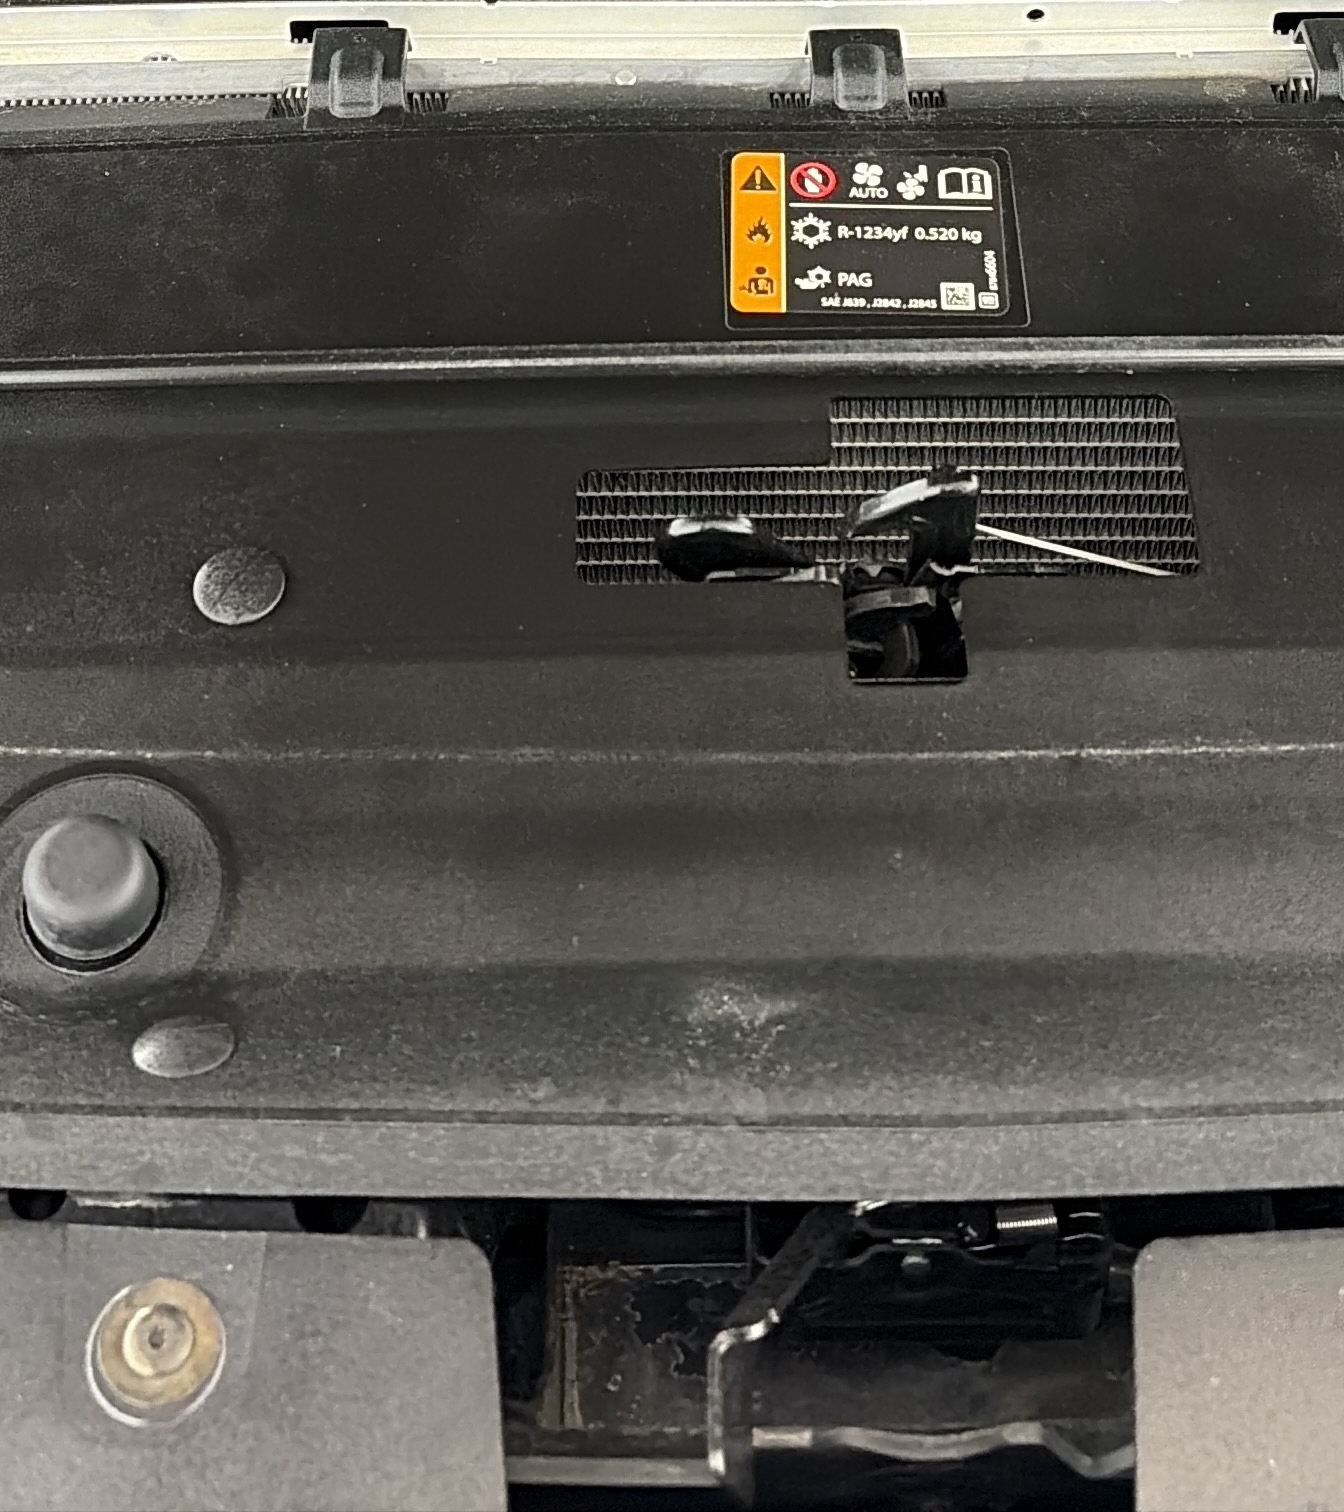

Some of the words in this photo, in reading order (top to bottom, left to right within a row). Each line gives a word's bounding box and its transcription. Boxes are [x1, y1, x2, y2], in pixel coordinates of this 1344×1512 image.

[849, 186, 889, 199] AUTO
[837, 225, 909, 242] R-1234yf
[914, 227, 959, 241] 0.520
[962, 227, 983, 244] kg
[837, 272, 873, 288] PAG
[820, 296, 841, 307] SAE
